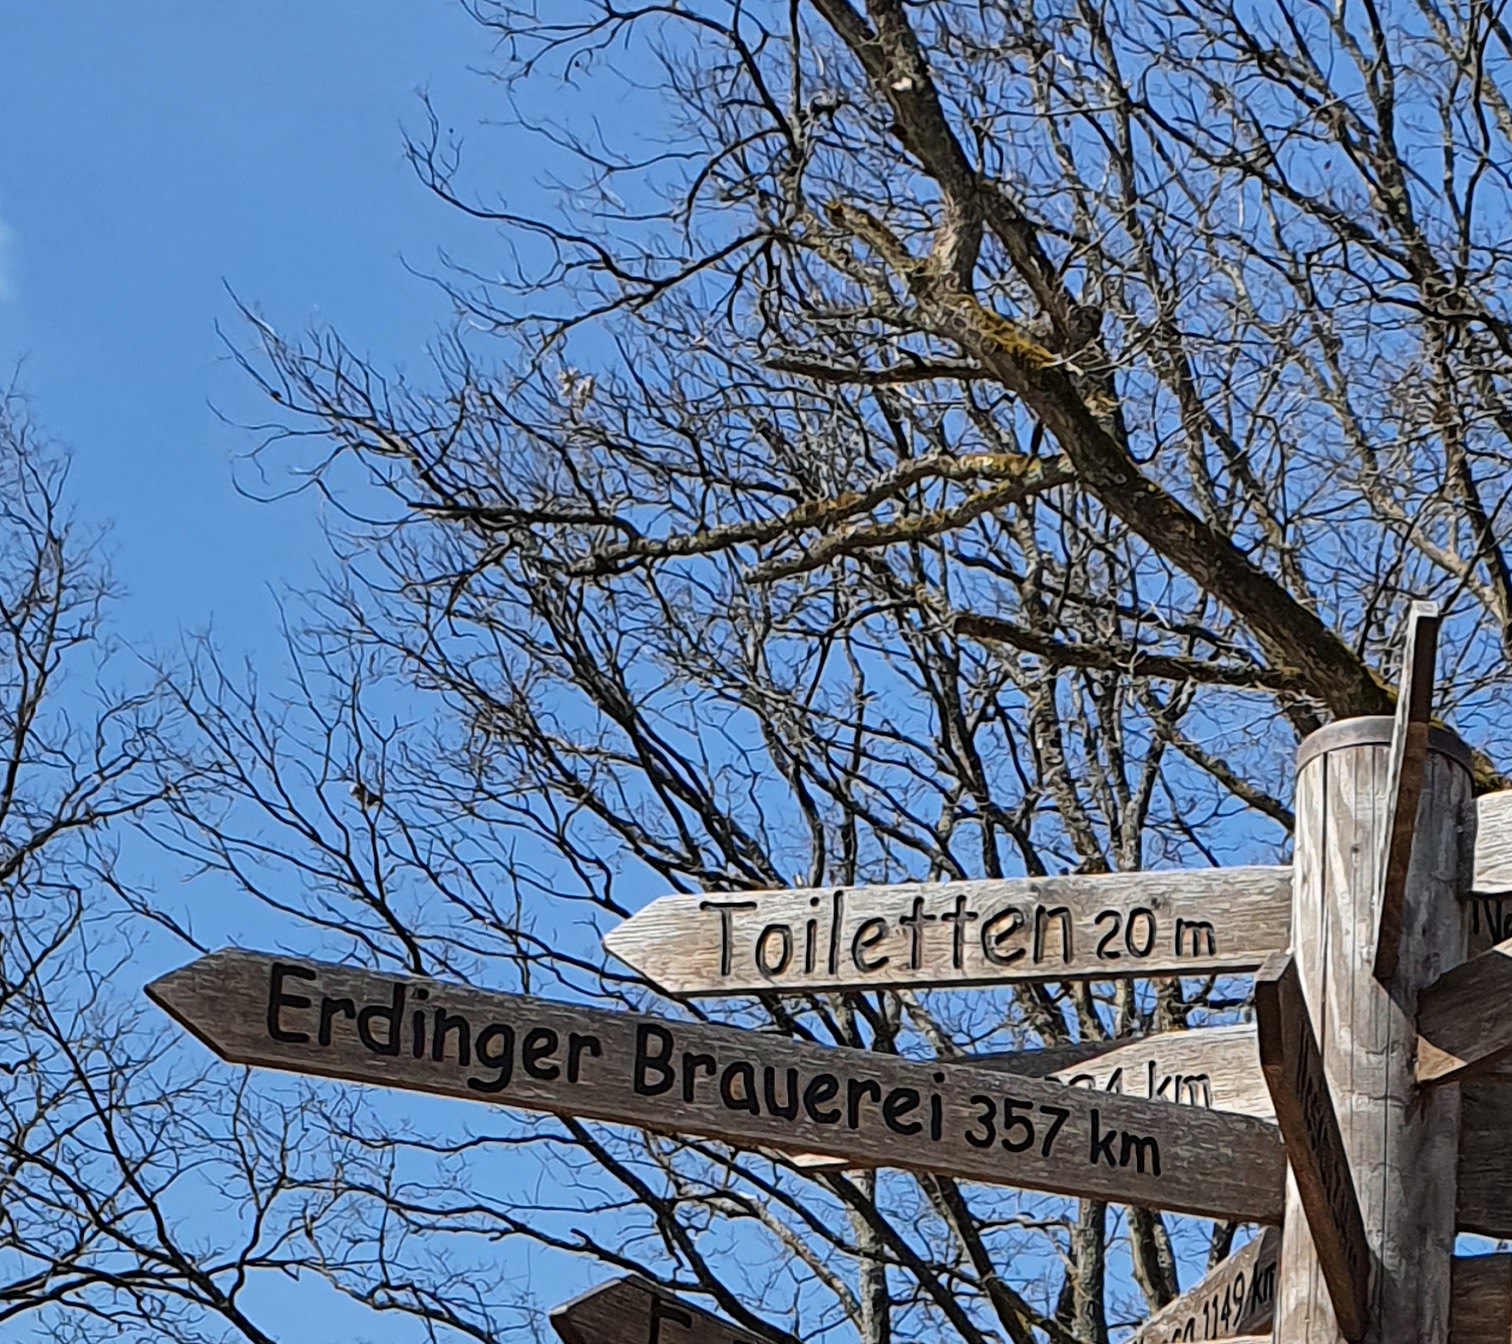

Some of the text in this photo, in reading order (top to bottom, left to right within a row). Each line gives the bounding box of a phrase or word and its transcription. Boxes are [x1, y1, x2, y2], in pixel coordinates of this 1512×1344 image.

[700, 892, 1216, 982] Toiletten 20 m
[266, 964, 1162, 1178] Erdinger Brauerei 357 km
